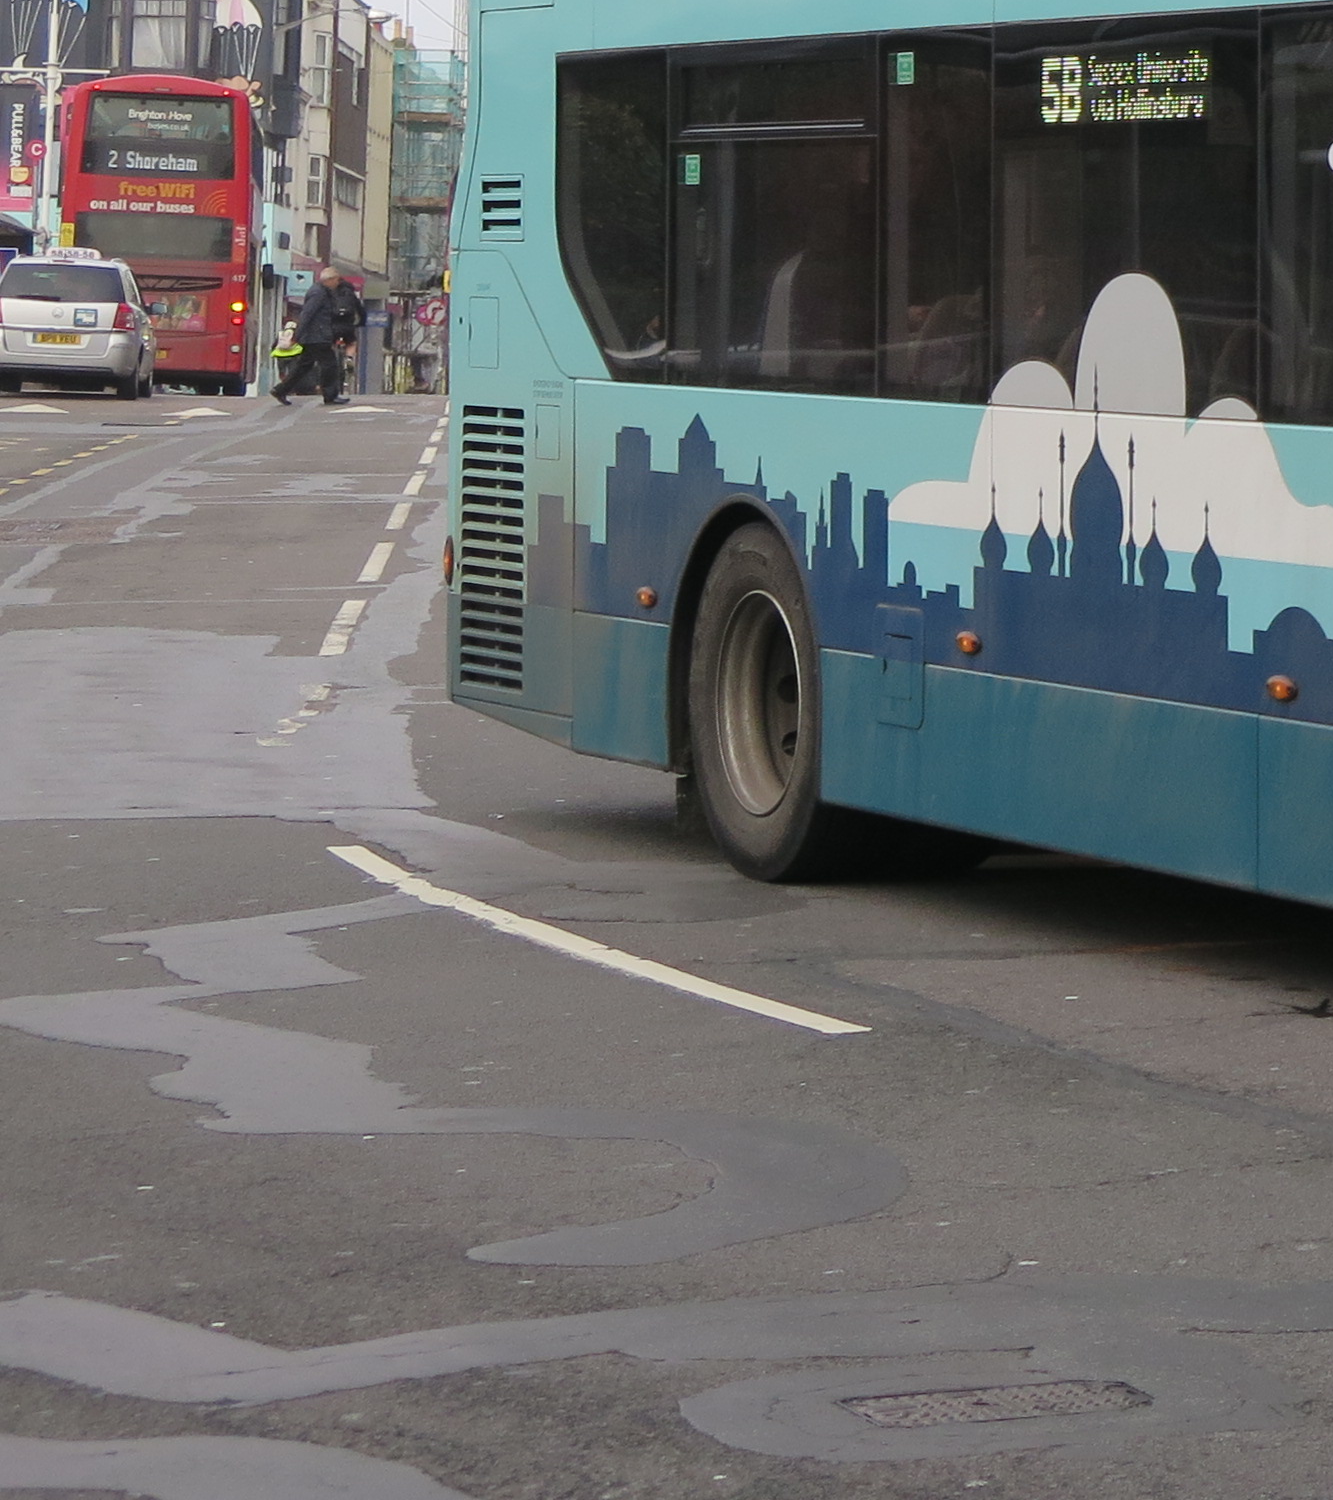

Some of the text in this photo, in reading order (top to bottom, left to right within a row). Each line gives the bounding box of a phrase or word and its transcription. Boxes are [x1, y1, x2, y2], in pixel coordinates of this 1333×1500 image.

[1041, 56, 1082, 123] 5B
[10, 103, 25, 167] PULL&BEAR
[31, 143, 42, 155] C
[108, 150, 198, 172] 2 Shoreham
[118, 182, 196, 198] free WiFi
[90, 199, 195, 213] on all our buses
